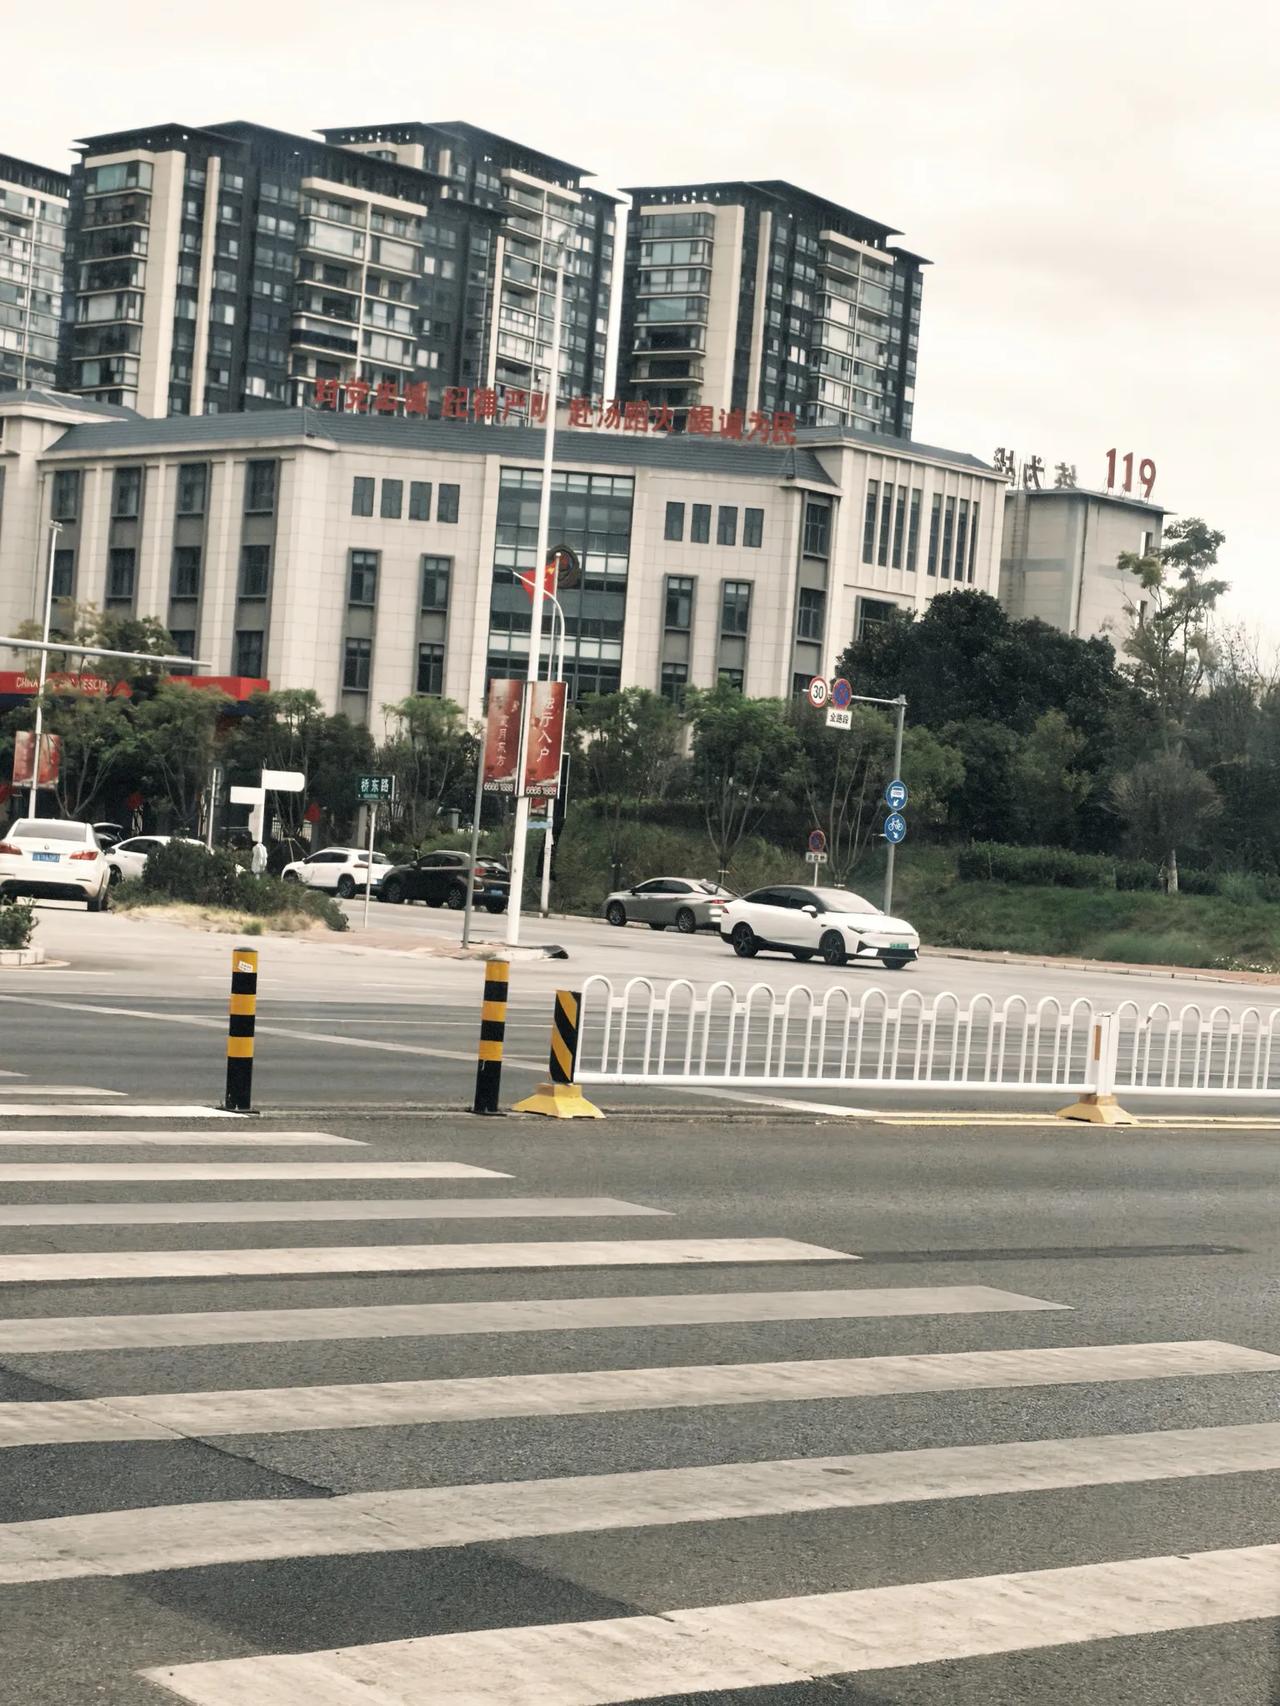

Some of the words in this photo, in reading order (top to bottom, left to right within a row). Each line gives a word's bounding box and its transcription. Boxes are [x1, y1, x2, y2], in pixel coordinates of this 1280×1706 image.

[568, 394, 674, 433] 赴汤蹈火
[688, 405, 797, 445] 竭诚为民
[1106, 448, 1156, 498] 119
[813, 685, 824, 699] 30
[829, 712, 849, 725] 全路段
